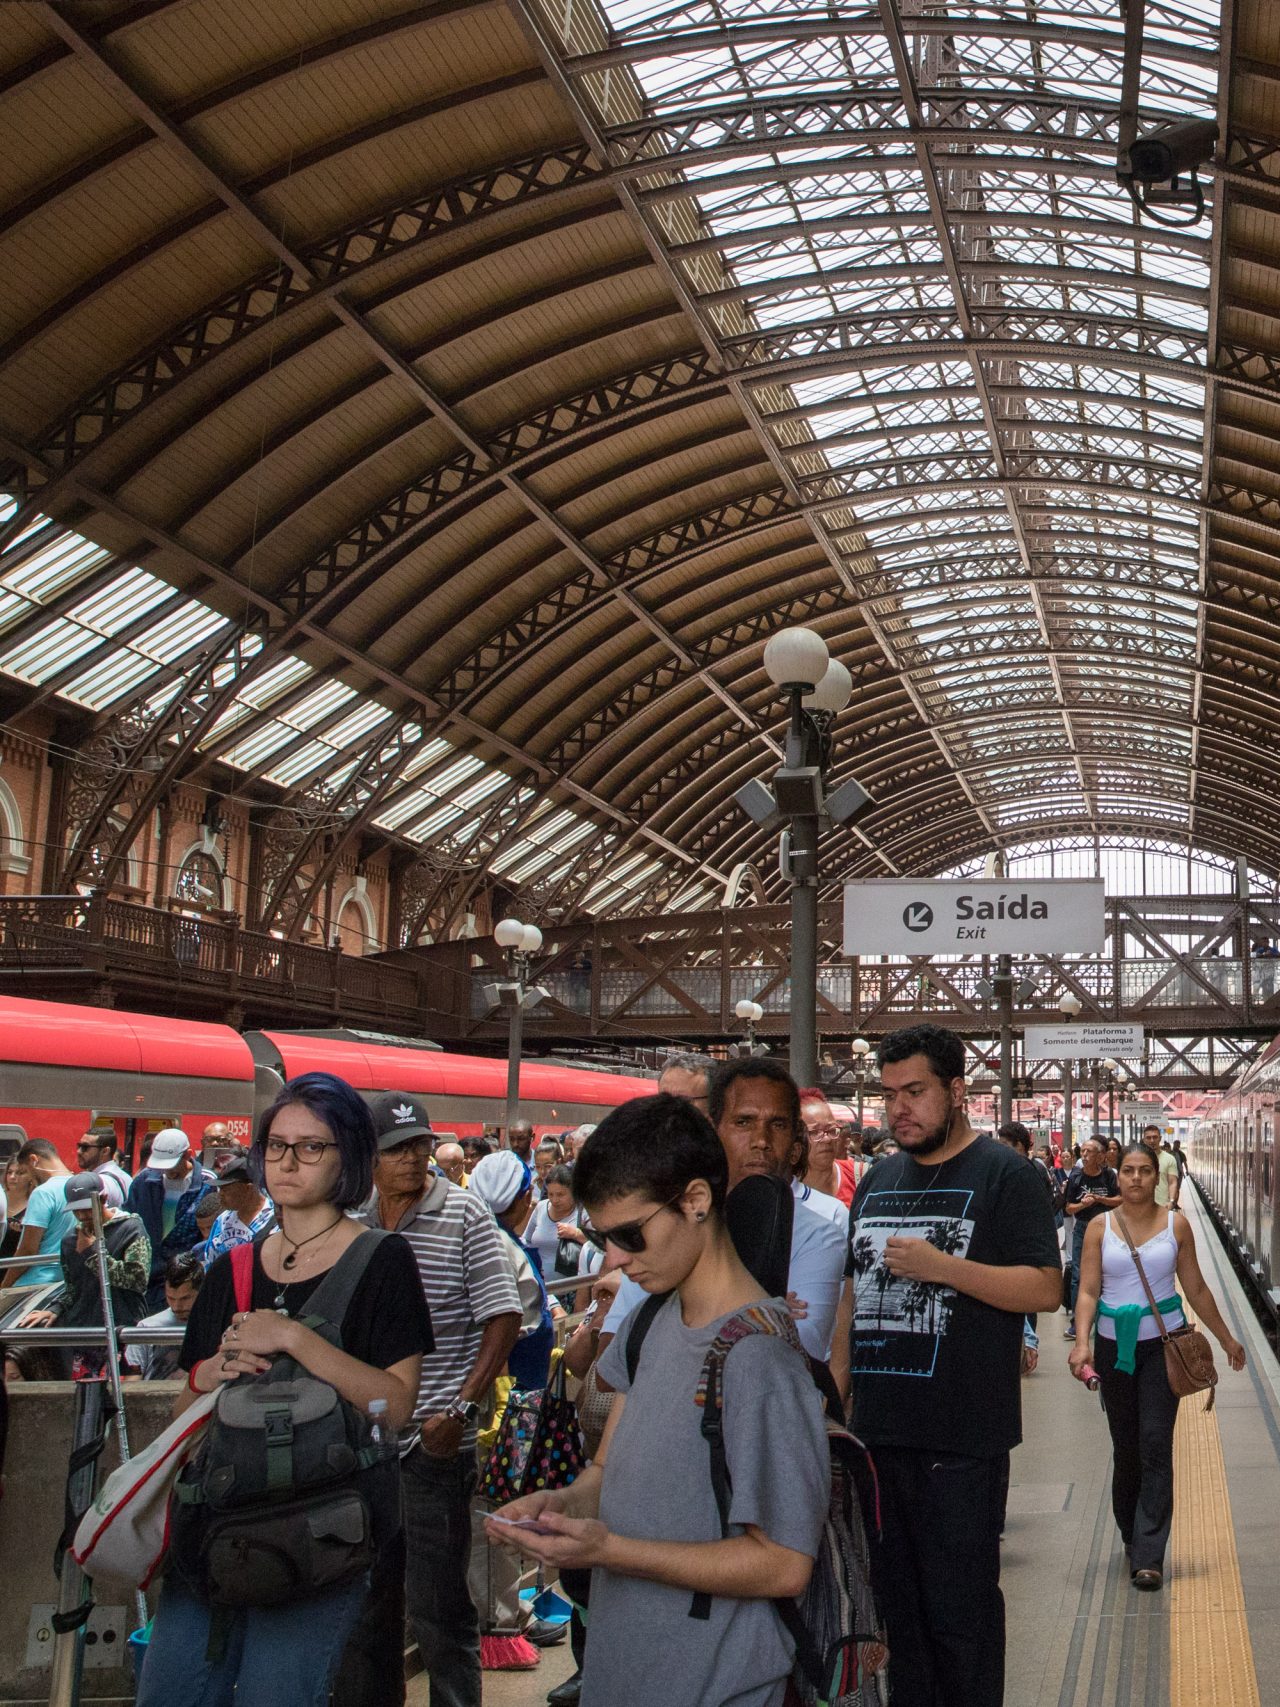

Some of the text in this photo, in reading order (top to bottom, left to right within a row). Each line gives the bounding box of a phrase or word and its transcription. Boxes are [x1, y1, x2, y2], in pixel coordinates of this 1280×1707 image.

[955, 893, 1048, 920] Saída
[956, 926, 986, 940] Exit
[1080, 1037, 1134, 1046] desembarque
[227, 1120, 249, 1136] D554
